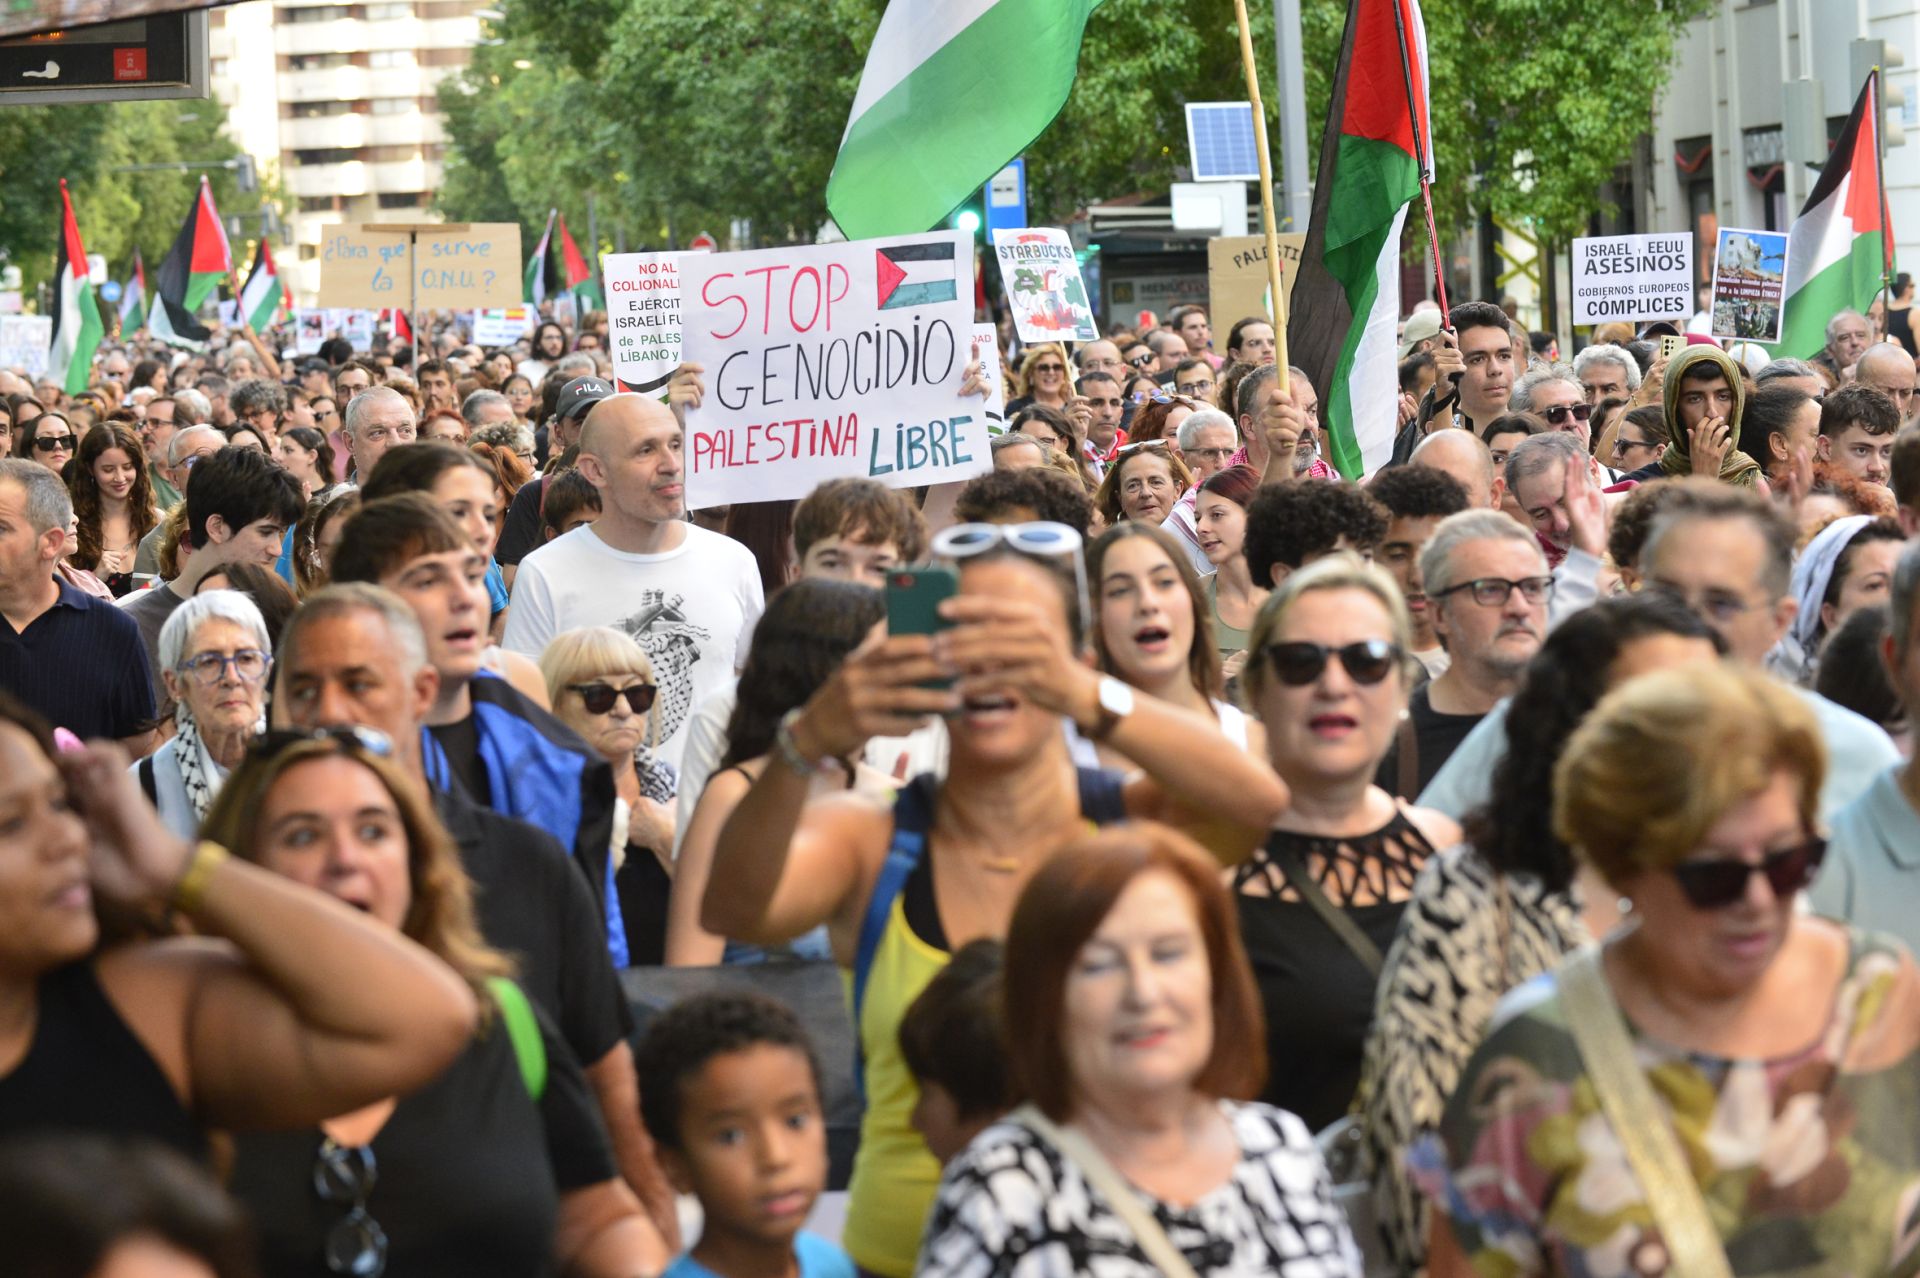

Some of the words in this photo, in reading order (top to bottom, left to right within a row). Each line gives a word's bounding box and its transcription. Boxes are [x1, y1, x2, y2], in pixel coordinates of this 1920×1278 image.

[999, 245, 1073, 260] STARBUCKS
[1233, 243, 1300, 269] PALETI
[1585, 243, 1633, 257] ISRAEL
[1648, 240, 1684, 254] EEUU
[638, 263, 658, 275] NO
[661, 262, 678, 273] AL
[1584, 254, 1686, 276] ASESINOS
[371, 266, 394, 292] la
[1578, 285, 1635, 297] GOBIERNOS
[1639, 283, 1690, 294] EUROPEOS
[701, 263, 850, 340] STOP
[1586, 295, 1685, 317] CÓMPLICES
[615, 312, 666, 329] ISRAELÍ
[618, 335, 634, 347] de
[620, 348, 669, 363] LÍBANO
[672, 351, 679, 362] y
[575, 383, 604, 396] FILA
